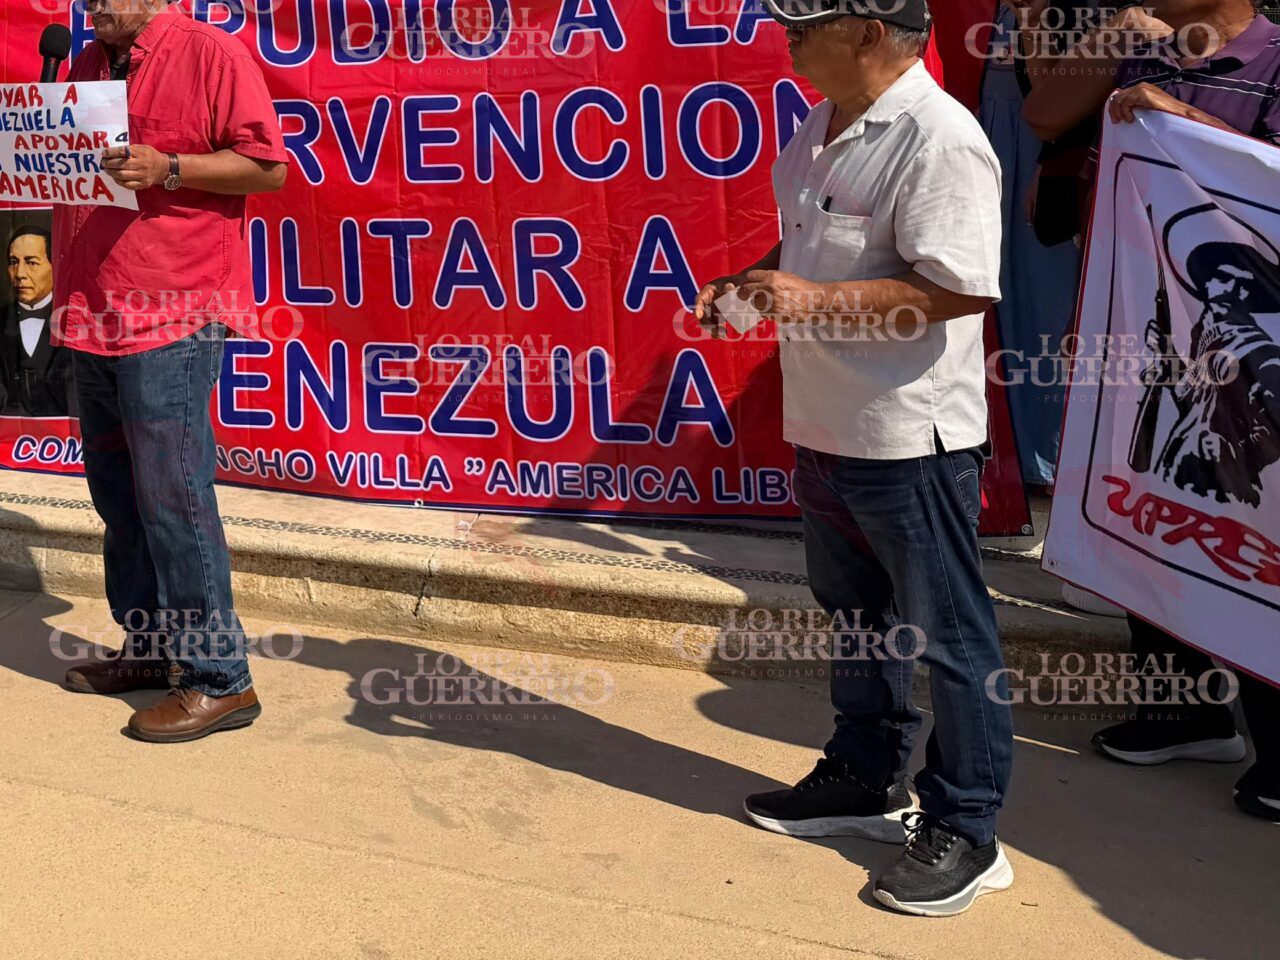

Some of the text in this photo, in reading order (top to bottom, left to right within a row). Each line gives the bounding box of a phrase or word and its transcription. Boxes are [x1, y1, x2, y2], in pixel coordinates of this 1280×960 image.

[62, 84, 78, 106] A
[14, 130, 110, 151] APOYAR
[14, 152, 106, 176] NUESTR
[623, 215, 699, 314] A
[326, 450, 453, 492] VILLA
[712, 465, 801, 506] LIB
